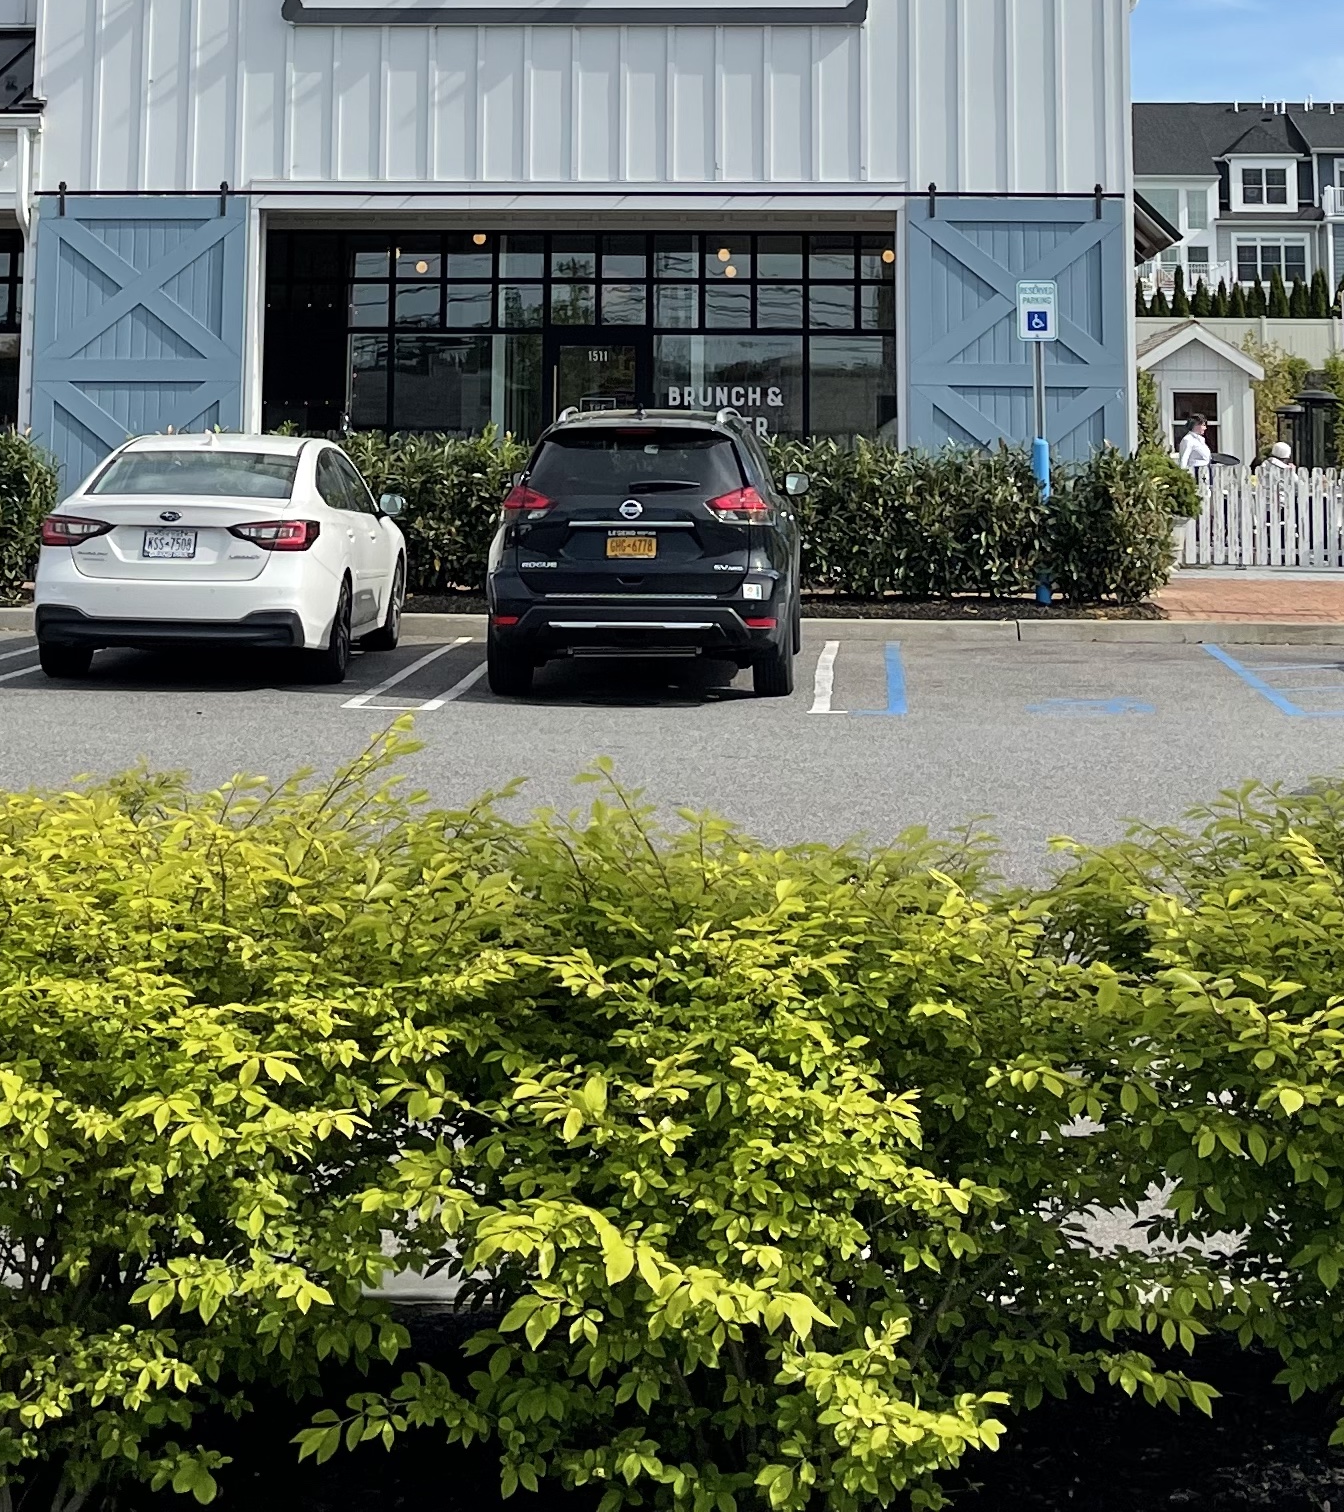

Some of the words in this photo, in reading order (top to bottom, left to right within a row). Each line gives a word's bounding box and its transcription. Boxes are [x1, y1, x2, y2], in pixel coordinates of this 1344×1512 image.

[588, 351, 608, 362] 1511
[668, 386, 761, 407] BRUNCH
[767, 387, 784, 407] &
